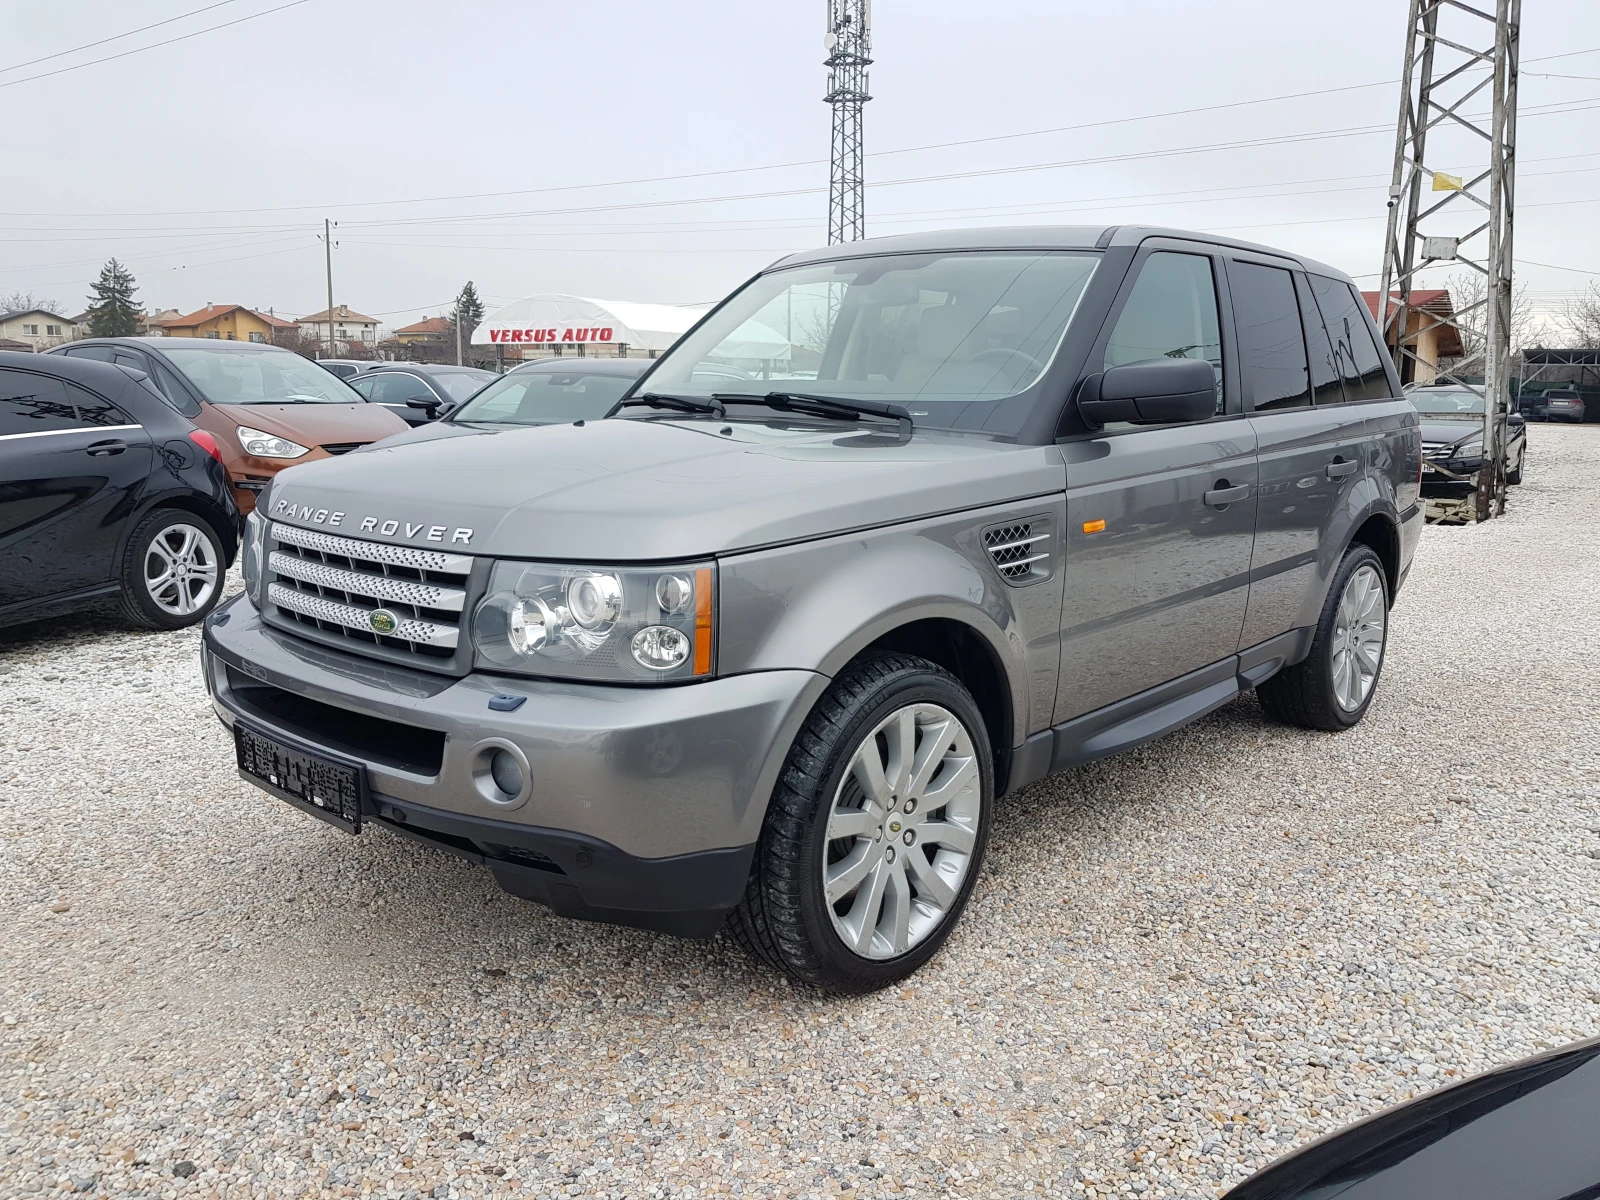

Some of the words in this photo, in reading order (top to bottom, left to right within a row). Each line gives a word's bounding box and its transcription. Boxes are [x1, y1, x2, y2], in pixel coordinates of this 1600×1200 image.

[489, 328, 557, 343] VERSUS
[561, 327, 614, 342] AUTO
[275, 499, 346, 526] RANGE
[360, 516, 474, 544] ROVER
